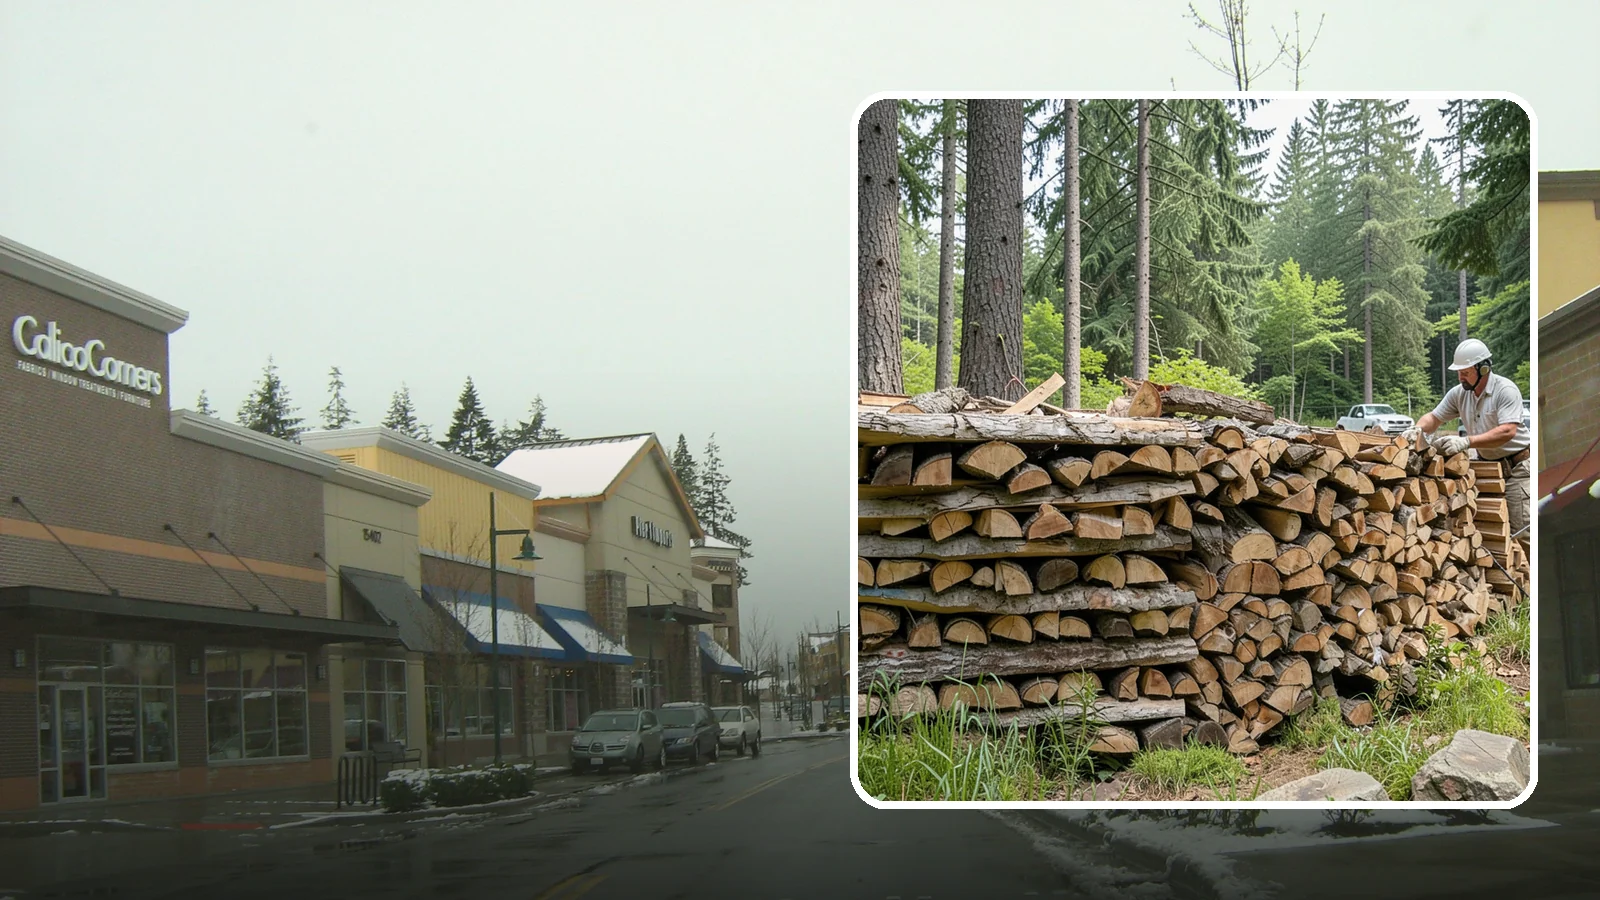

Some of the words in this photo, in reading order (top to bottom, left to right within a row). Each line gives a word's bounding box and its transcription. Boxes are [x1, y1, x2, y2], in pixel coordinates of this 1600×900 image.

[16, 359, 47, 378] FABRICS
[51, 369, 79, 387] WINDOW
[78, 378, 117, 399] TREATMENTS
[120, 390, 151, 409] FURNITURE
